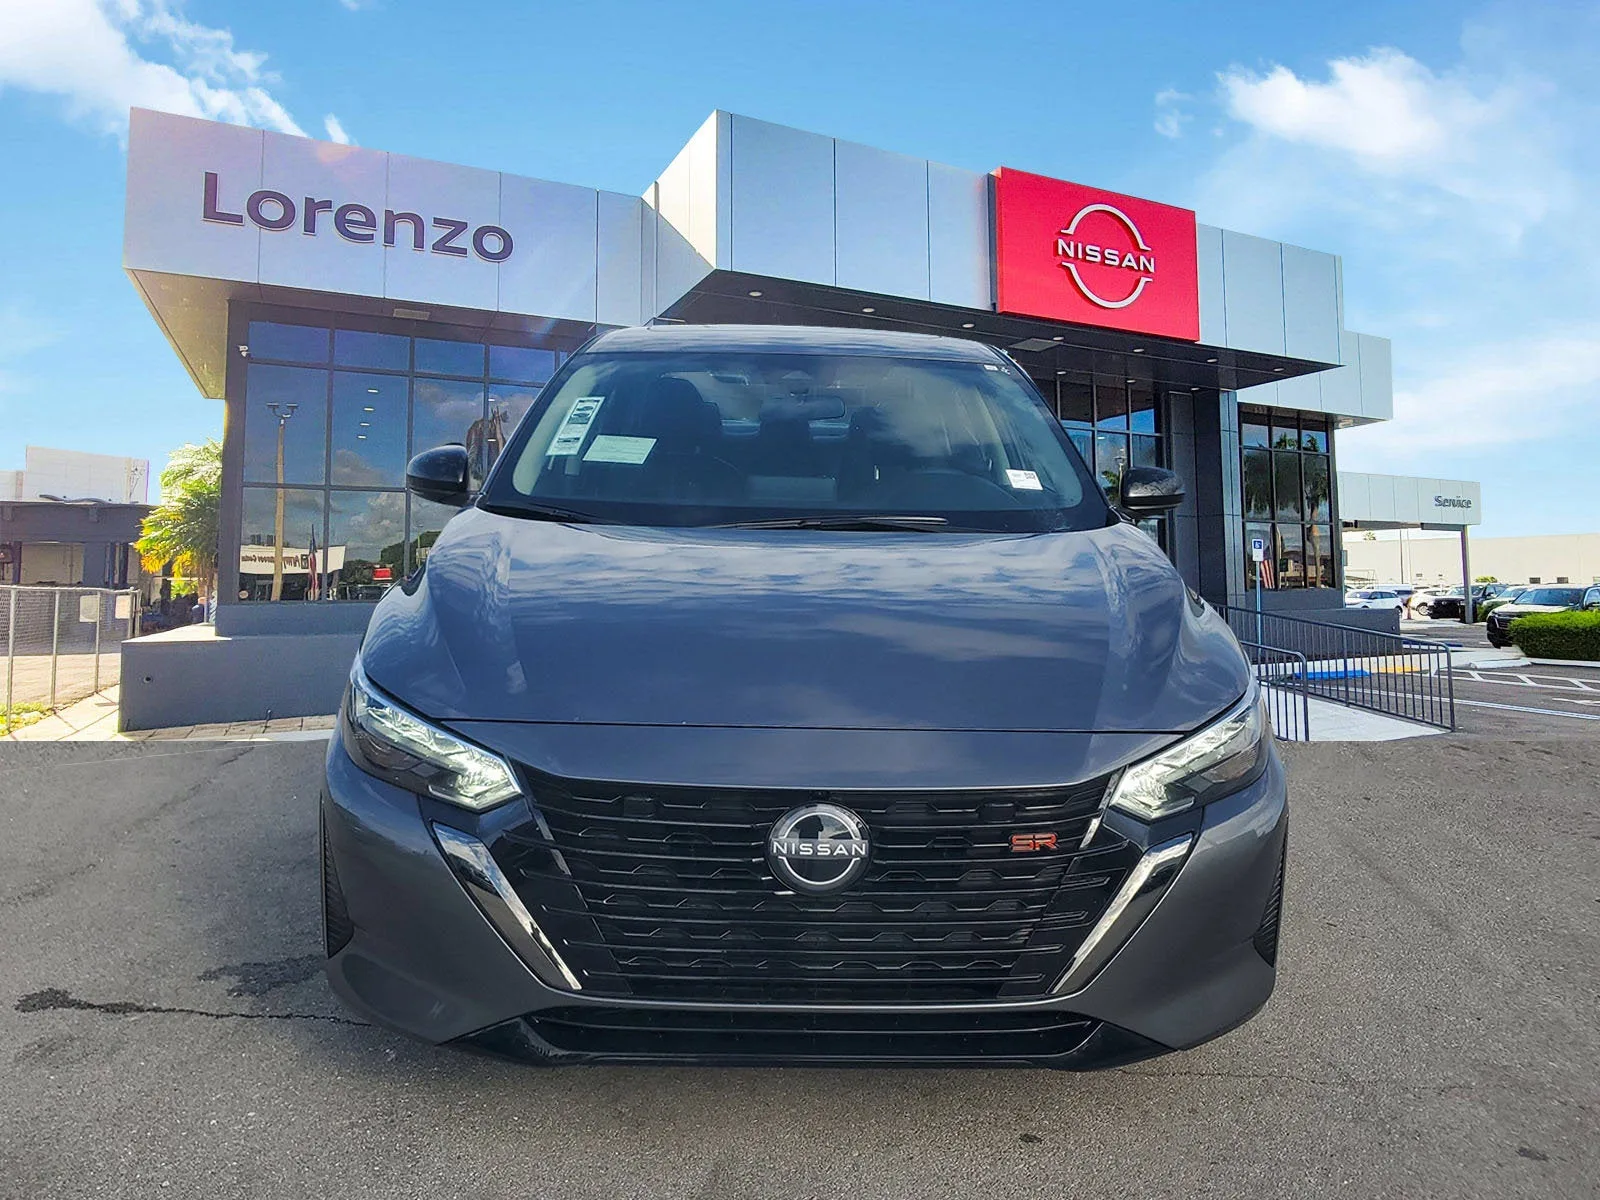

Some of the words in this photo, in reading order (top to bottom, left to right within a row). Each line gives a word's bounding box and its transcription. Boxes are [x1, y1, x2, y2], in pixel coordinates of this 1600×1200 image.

[203, 171, 514, 262] Lorenzo
[1057, 238, 1155, 273] NISSAN
[1434, 495, 1472, 509] Service
[773, 841, 866, 856] NISSAN
[1011, 833, 1057, 852] SR
